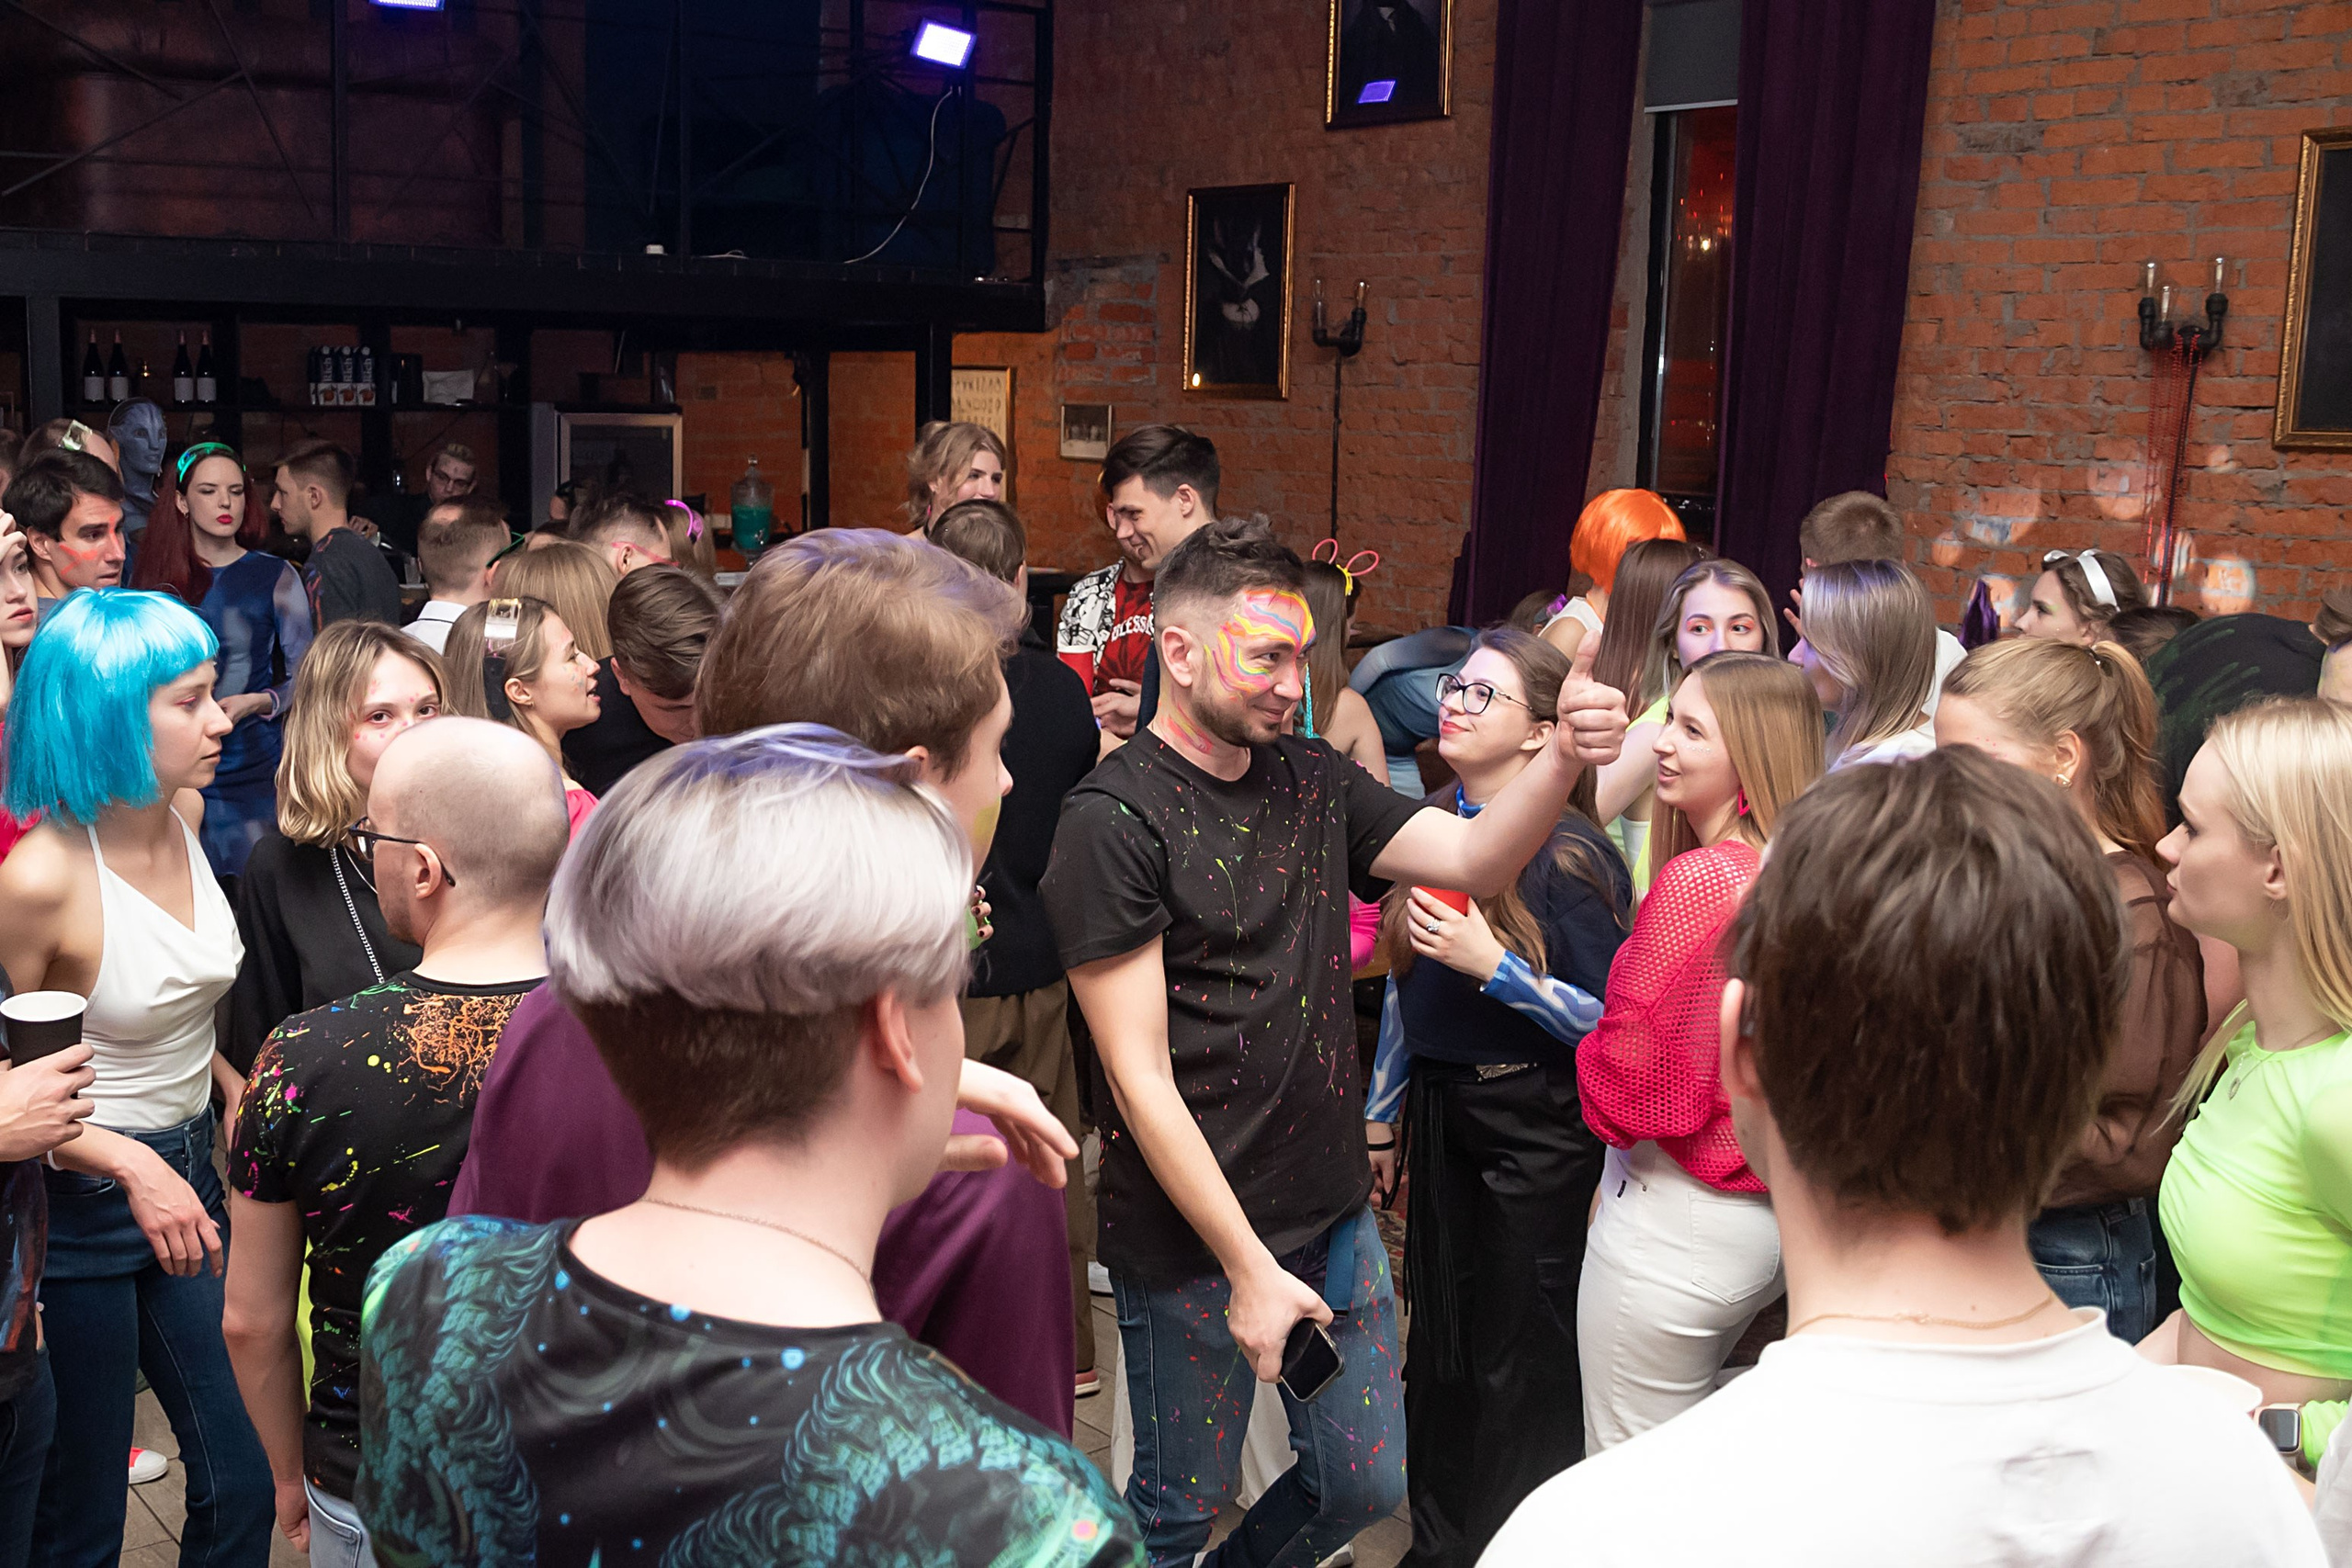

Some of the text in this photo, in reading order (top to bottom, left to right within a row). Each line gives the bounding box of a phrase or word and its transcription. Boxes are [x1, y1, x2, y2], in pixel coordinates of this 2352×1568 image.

[323, 357, 333, 381] Rich
[344, 357, 353, 382] Rich
[363, 358, 372, 382] Rich
